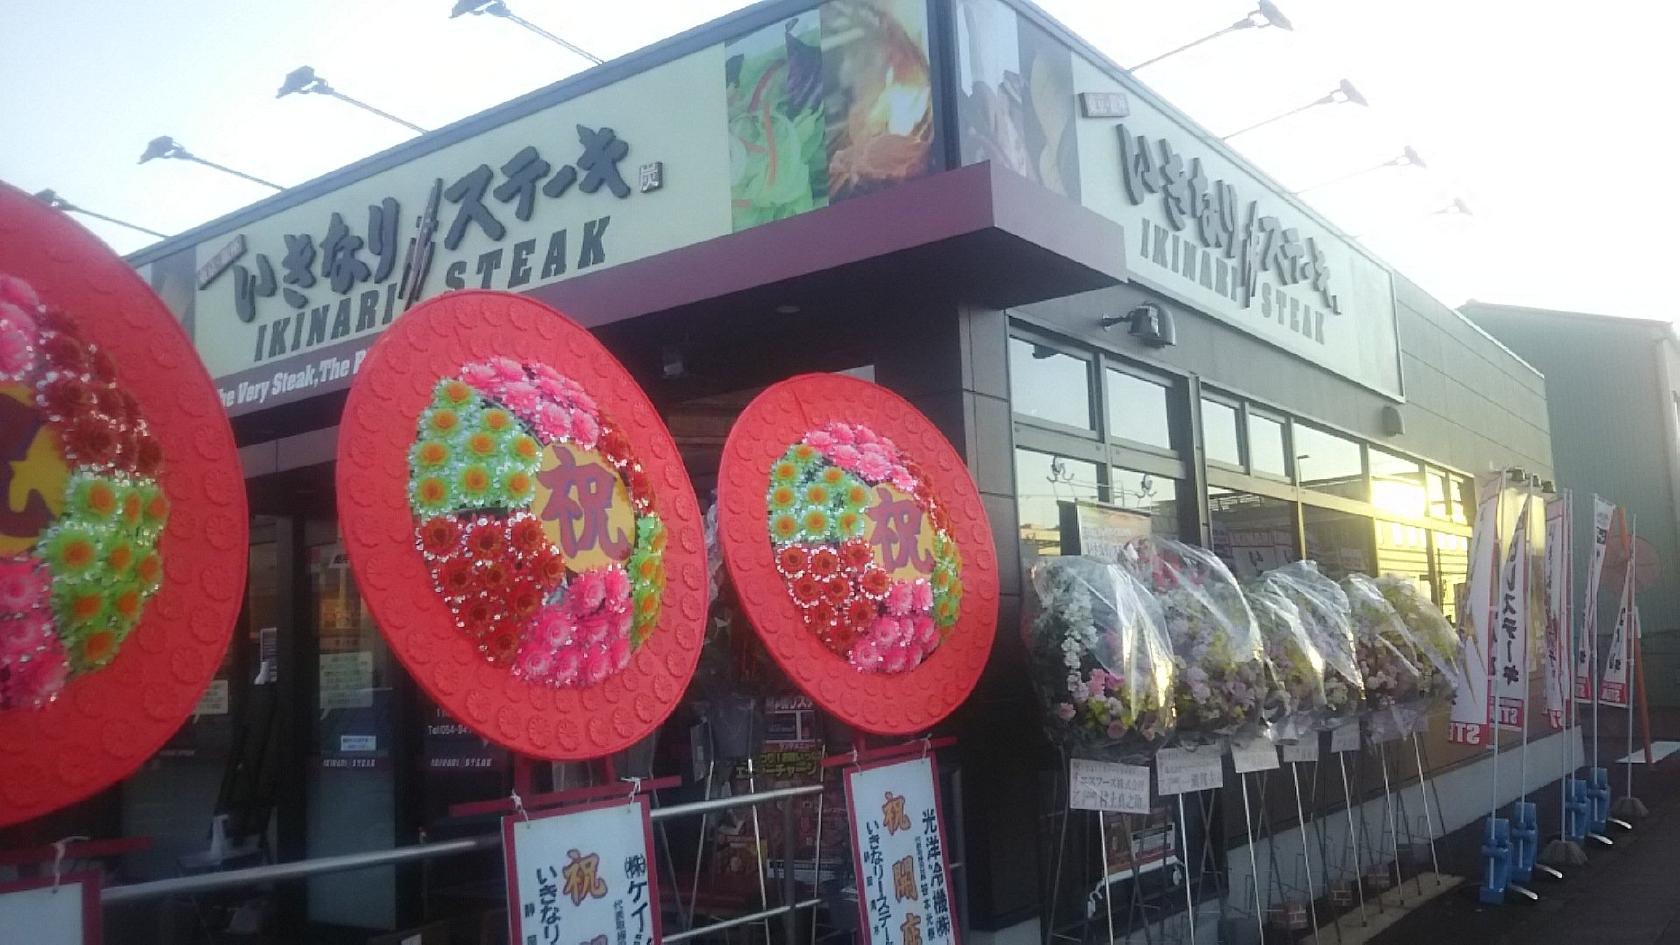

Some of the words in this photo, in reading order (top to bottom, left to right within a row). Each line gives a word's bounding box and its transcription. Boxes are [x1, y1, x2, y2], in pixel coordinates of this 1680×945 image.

[254, 282, 399, 361] IKINARI
[446, 216, 611, 291] STEAK
[1140, 218, 1238, 302] IKINARI
[1261, 282, 1325, 345] STEAK
[237, 380, 270, 404] Very
[536, 445, 632, 560] 祝
[864, 487, 936, 574] 祝
